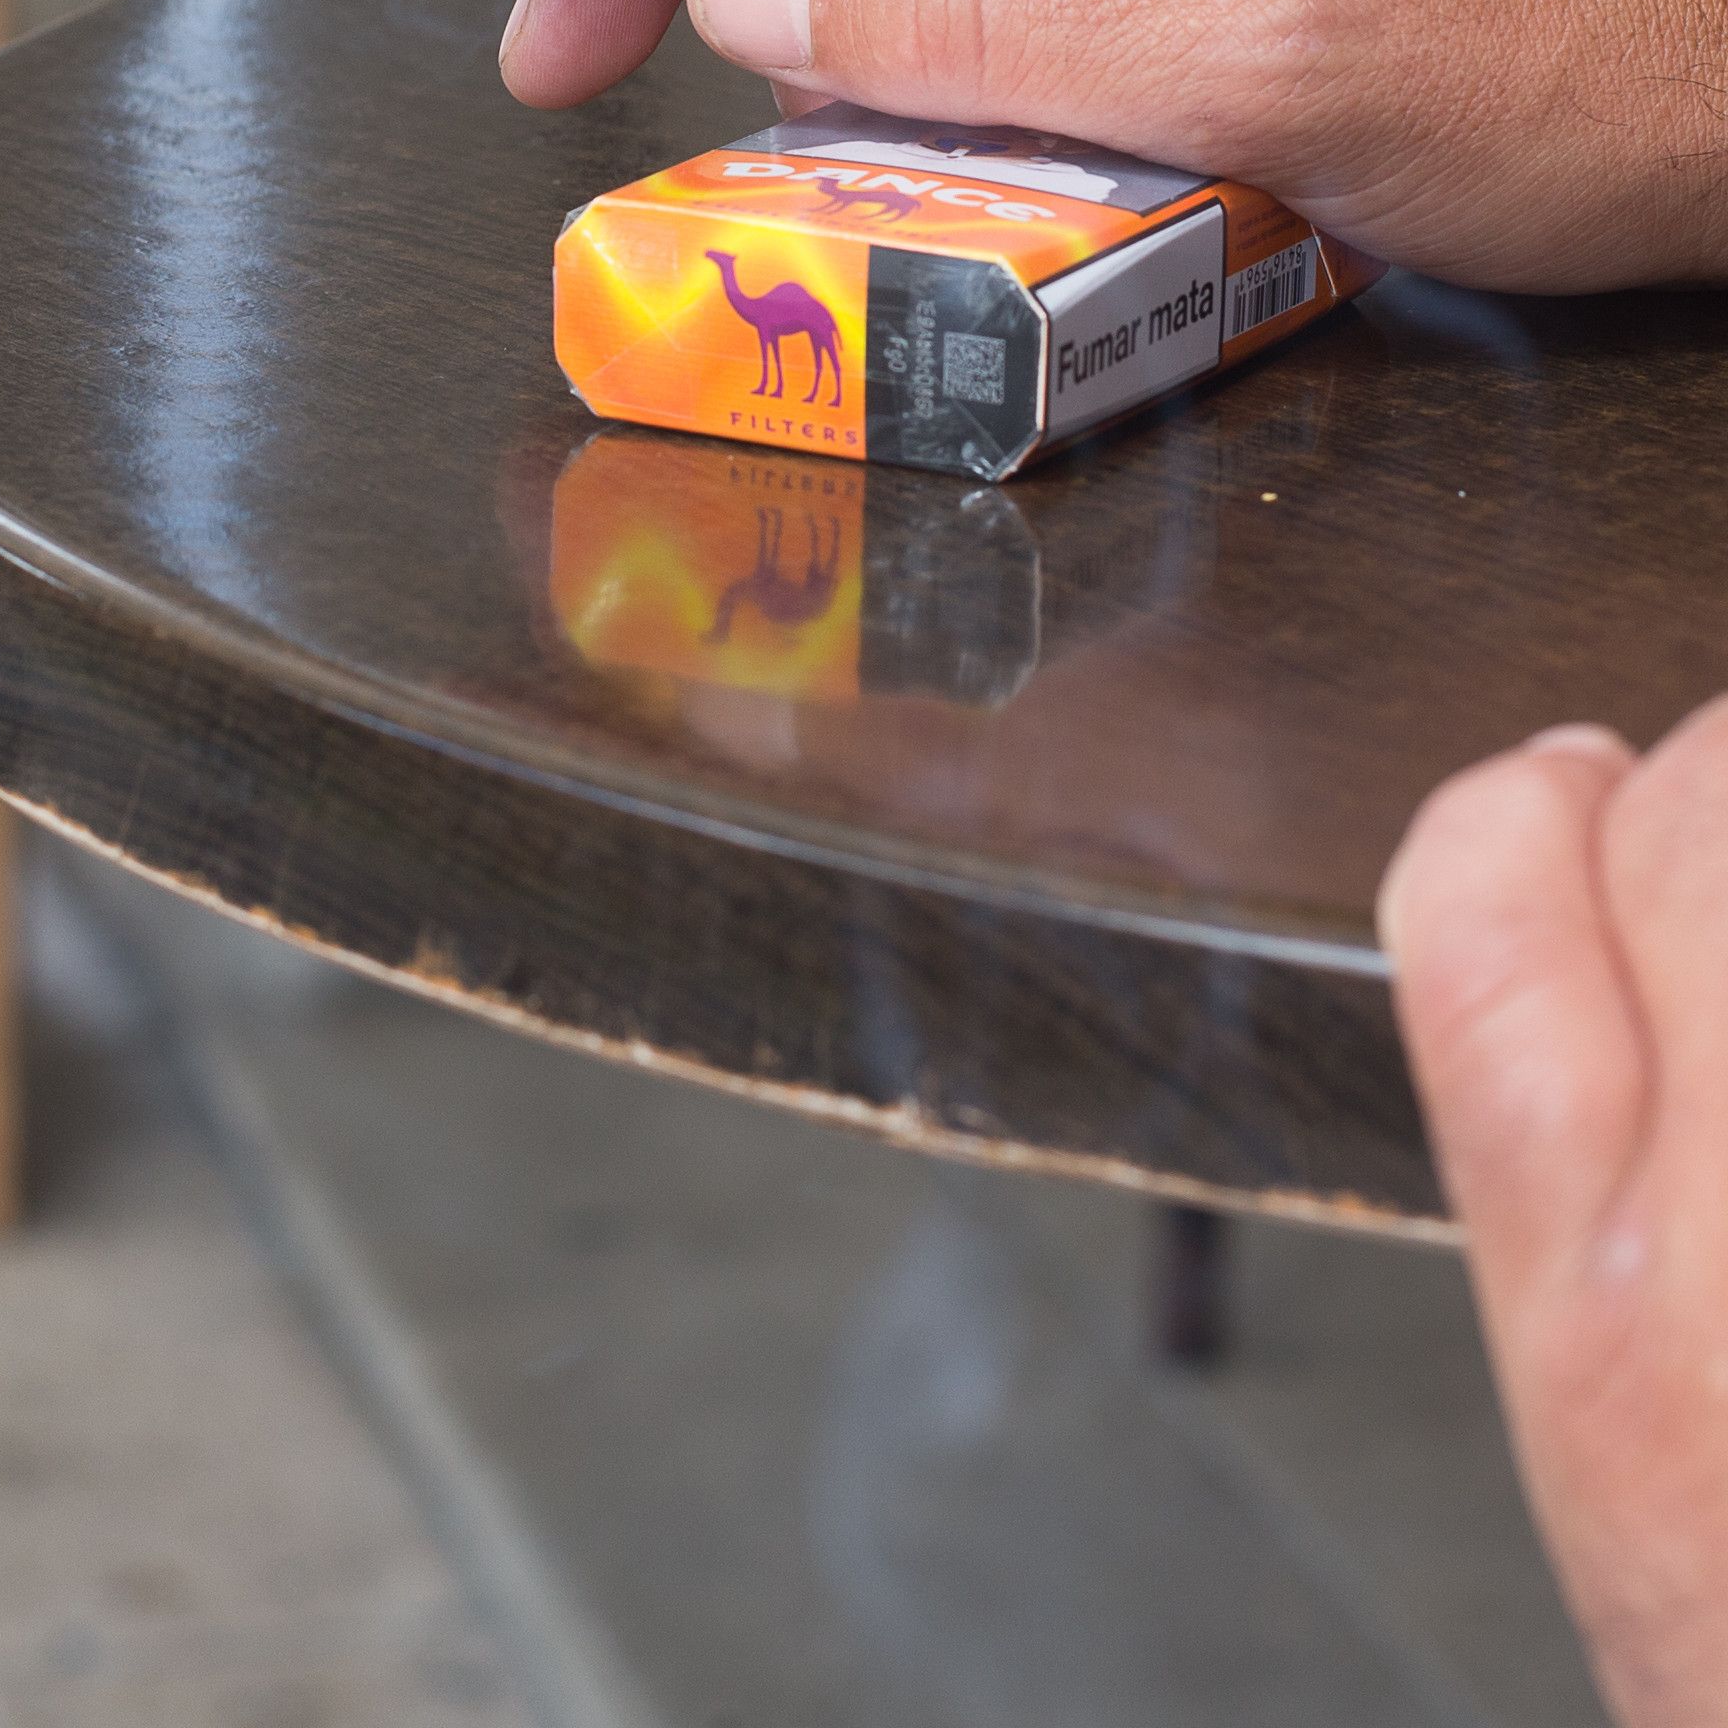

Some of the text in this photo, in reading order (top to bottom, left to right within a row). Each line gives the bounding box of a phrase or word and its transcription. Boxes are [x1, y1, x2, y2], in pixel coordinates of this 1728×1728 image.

[723, 161, 1056, 222] DANCE
[1057, 279, 1214, 394] Fumar mata
[729, 410, 858, 445] FILTERS
